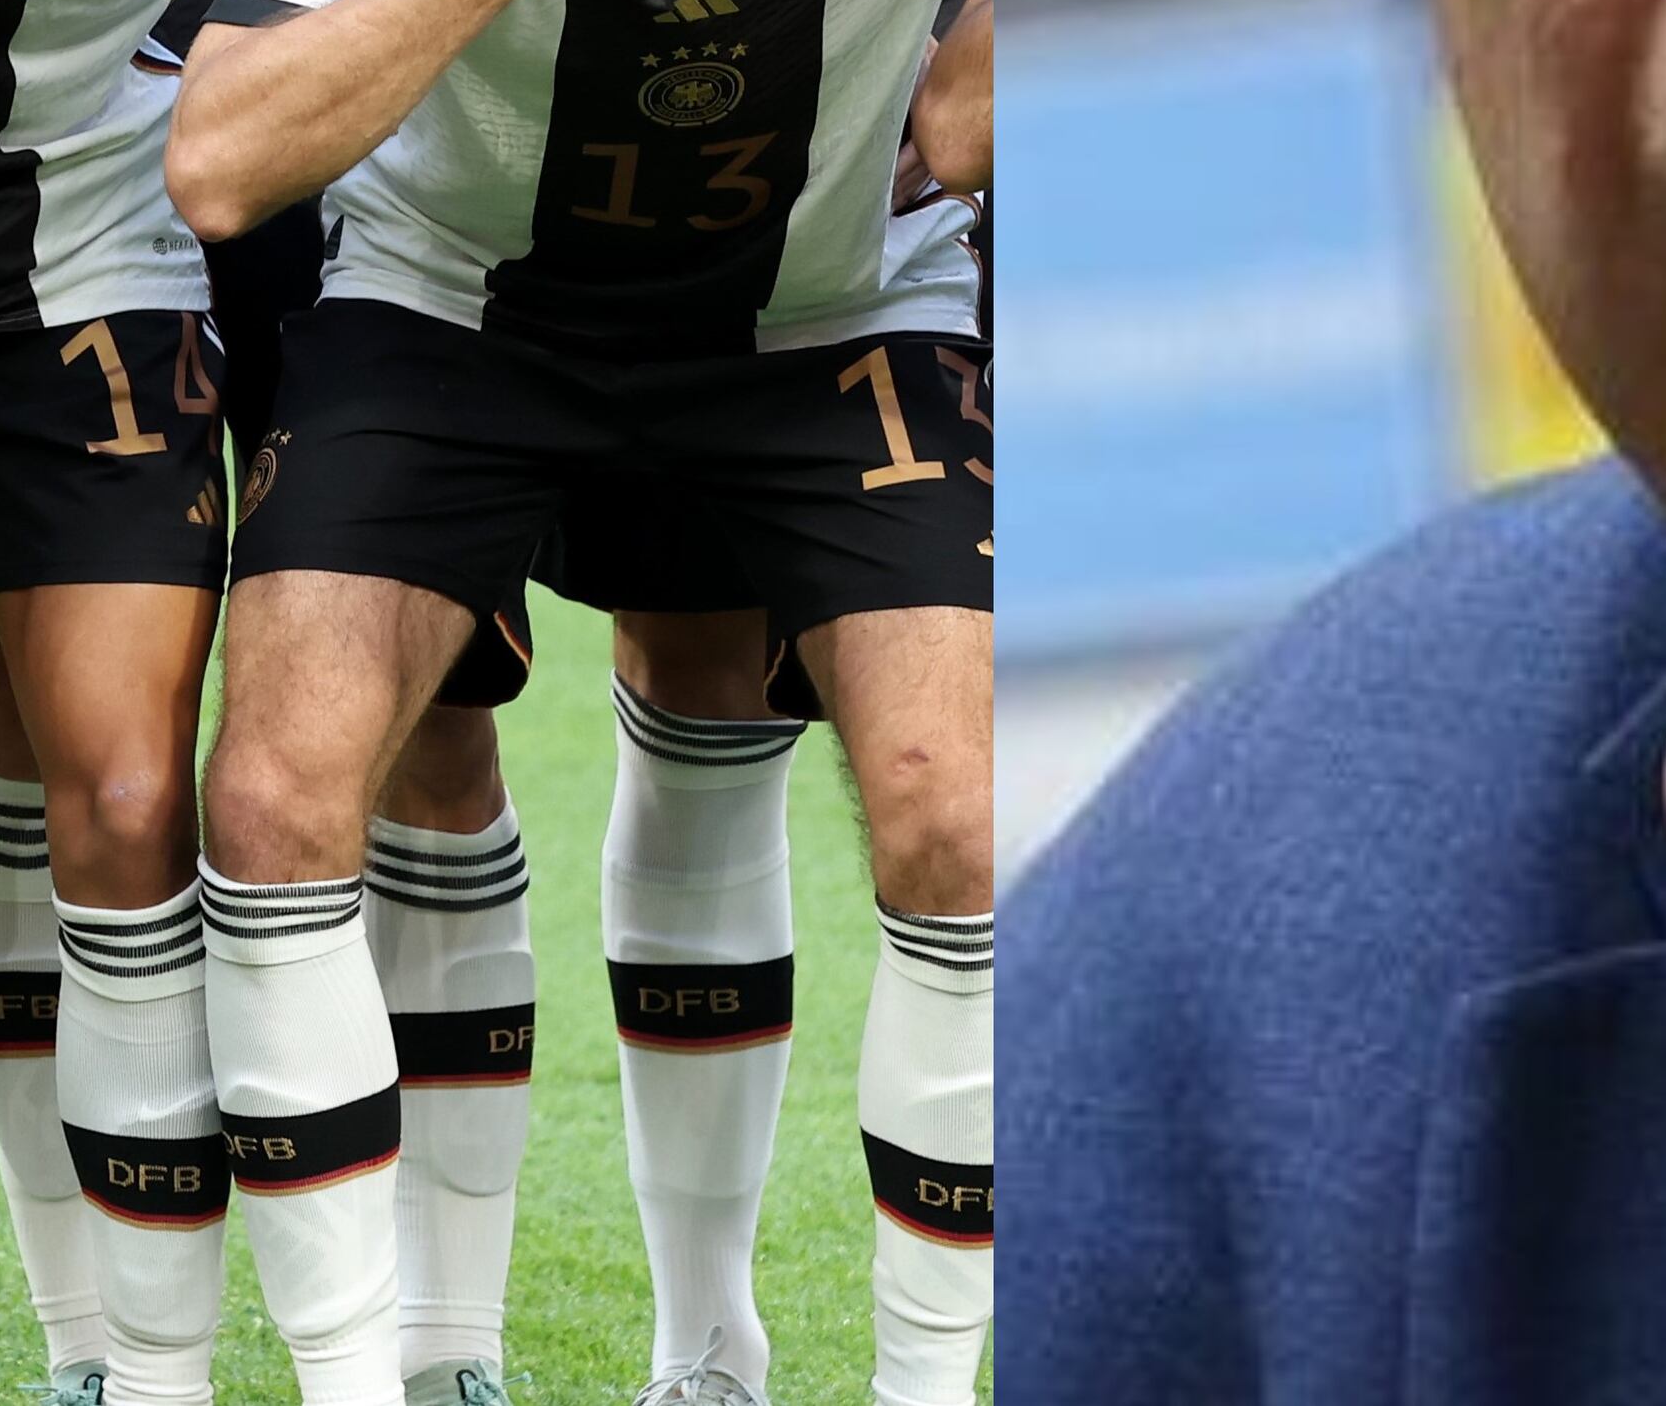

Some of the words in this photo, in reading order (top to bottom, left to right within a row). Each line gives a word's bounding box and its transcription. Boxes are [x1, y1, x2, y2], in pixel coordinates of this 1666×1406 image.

[571, 130, 780, 231] 13
[639, 987, 741, 1017] DFB
[107, 1157, 201, 1193] DFB
[918, 1178, 993, 1212] DF
